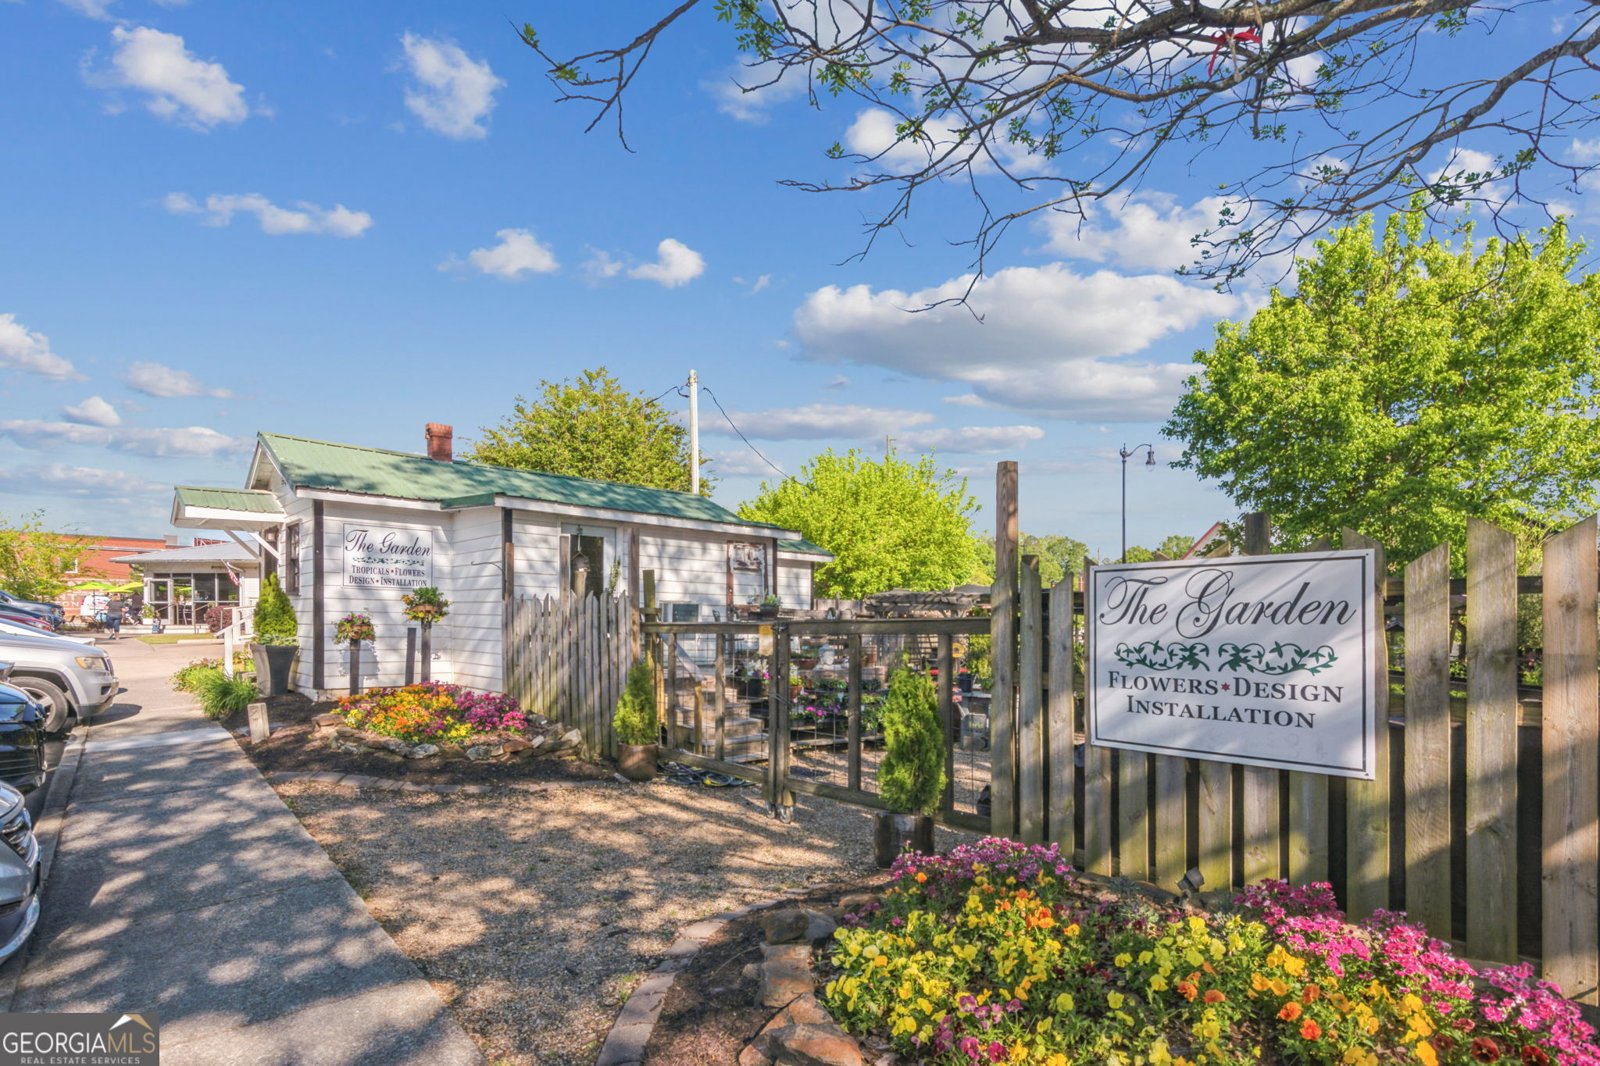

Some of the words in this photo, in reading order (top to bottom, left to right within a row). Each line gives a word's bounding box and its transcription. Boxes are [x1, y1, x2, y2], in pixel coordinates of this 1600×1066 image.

[345, 529, 374, 552] The
[380, 531, 431, 557] Garden
[349, 575, 375, 585] DESIGN
[380, 577, 427, 587] INSTALLATION
[352, 565, 390, 576] TROPICALS
[394, 567, 425, 577] FLOWERS
[1100, 576, 1169, 626] The
[1175, 568, 1357, 639] Garden
[1108, 670, 1219, 696] FLOWERS
[1233, 676, 1344, 703] DESIGN
[1126, 695, 1316, 729] INSTALLATION
